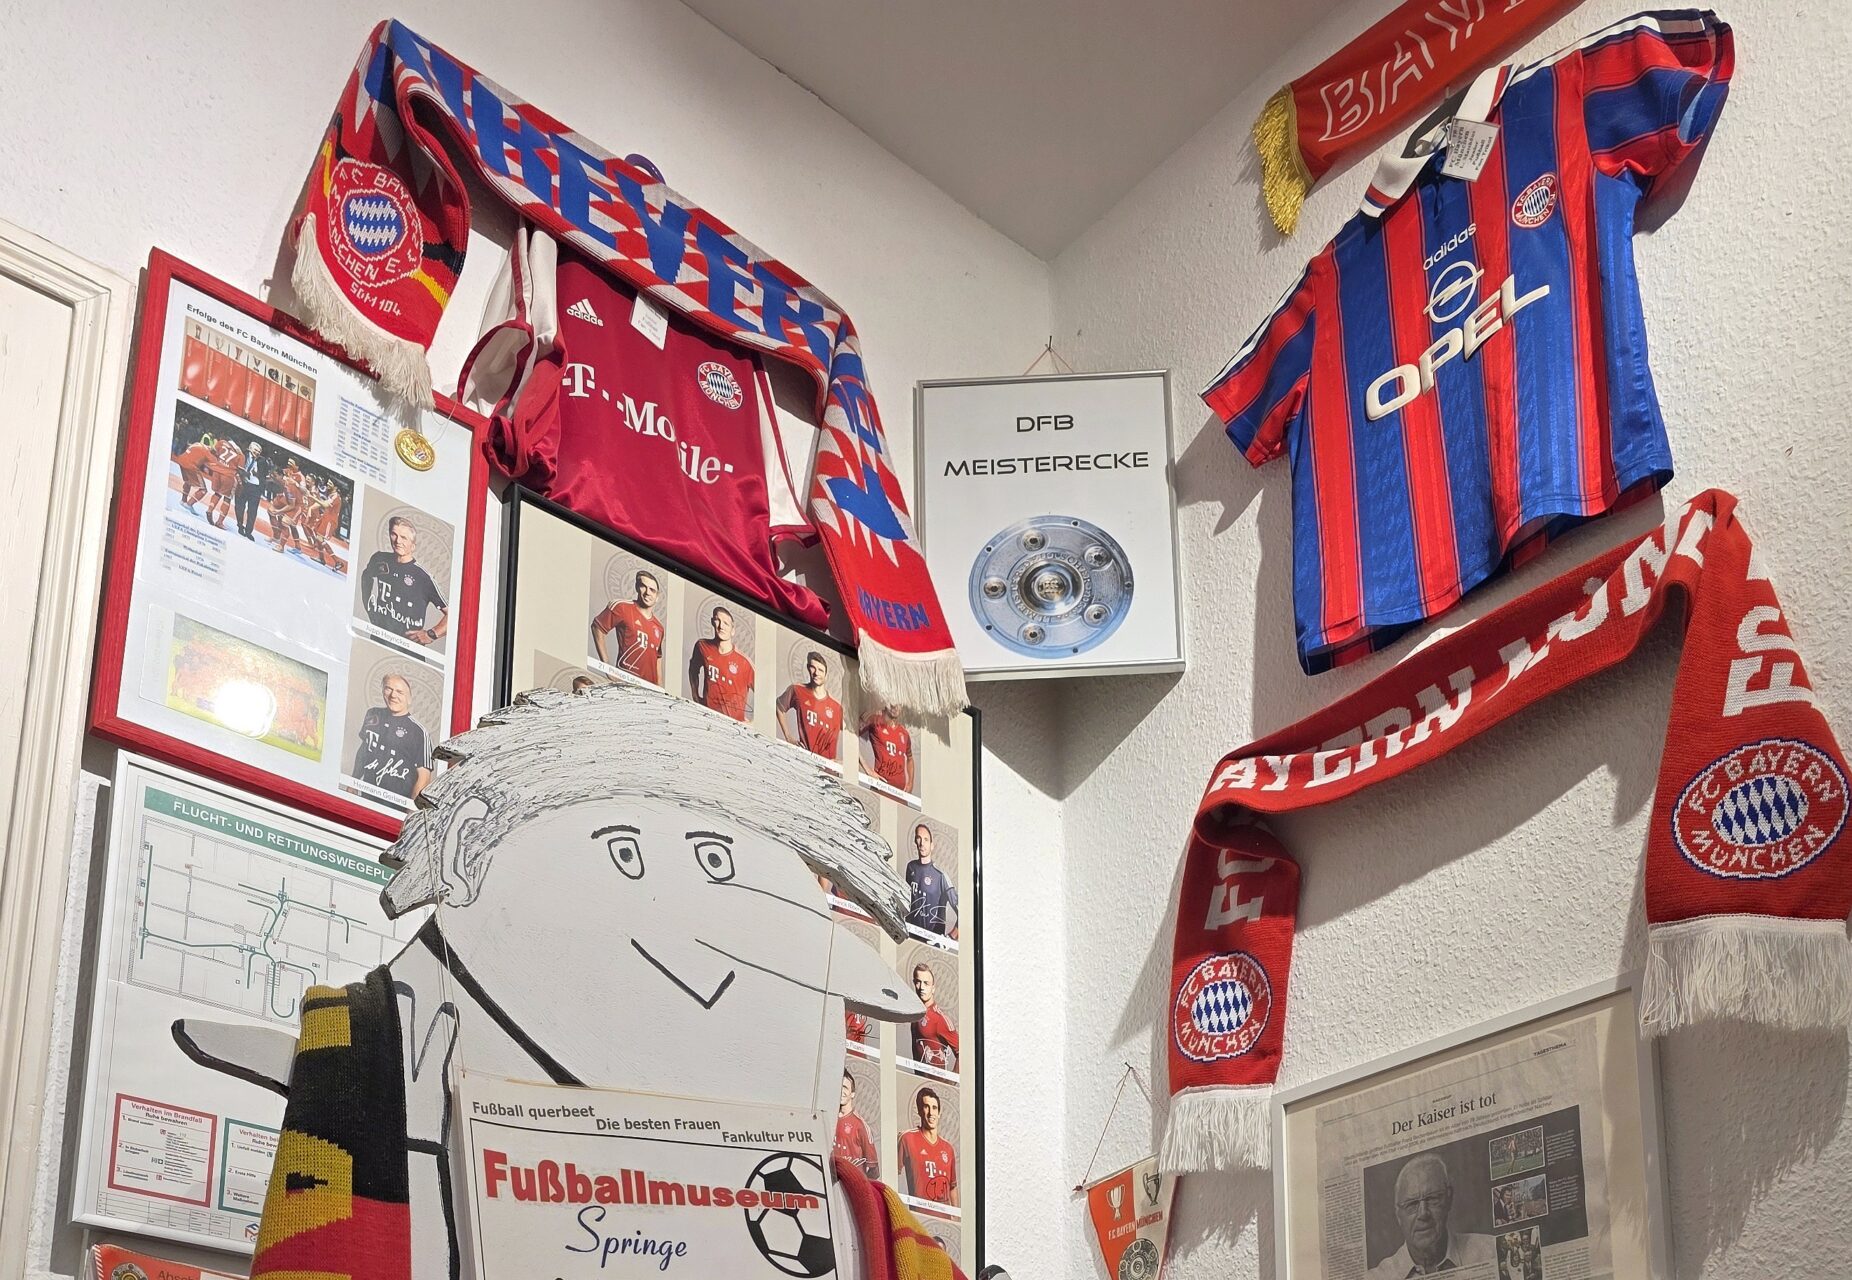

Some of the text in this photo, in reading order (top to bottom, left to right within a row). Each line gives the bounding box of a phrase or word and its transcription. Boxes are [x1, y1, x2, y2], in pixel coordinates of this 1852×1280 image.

[1318, 0, 1526, 142] BAY
[374, 172, 419, 249] BAYERN
[1423, 222, 1478, 272] adidas
[186, 303, 318, 375] Erfolge des FC Bayern München
[566, 307, 604, 327] adidas
[1366, 274, 1550, 421] OPEL
[622, 393, 721, 484] Moile
[1016, 414, 1074, 433] DFB
[943, 452, 1149, 477] MEISTERECKE
[1207, 666, 1476, 794] AYERN
[1688, 746, 1842, 816] FC BAYERN
[173, 800, 395, 880] FLUCHT- UND RETTUNGSWEGEPL
[1690, 823, 1828, 871] MÜNCHEN
[1181, 960, 1266, 1008] FC BAYERN
[1180, 1018, 1263, 1054] MÜNCHEN
[131, 1102, 163, 1115] Verhalten
[174, 1112, 203, 1124] Brandfall
[239, 1128, 268, 1141] Verhalten
[472, 1101, 595, 1121] Fußball querbeet
[596, 1117, 721, 1132] Die besten Frauen
[1391, 1117, 1413, 1136] Der
[1417, 1104, 1457, 1128] Kaiser
[1459, 1099, 1476, 1116] ist
[1478, 1092, 1497, 1109] tot
[722, 1131, 814, 1144] Fankultur PUR
[483, 1148, 820, 1211] Fußballmuseum
[565, 1205, 688, 1271] Springe
